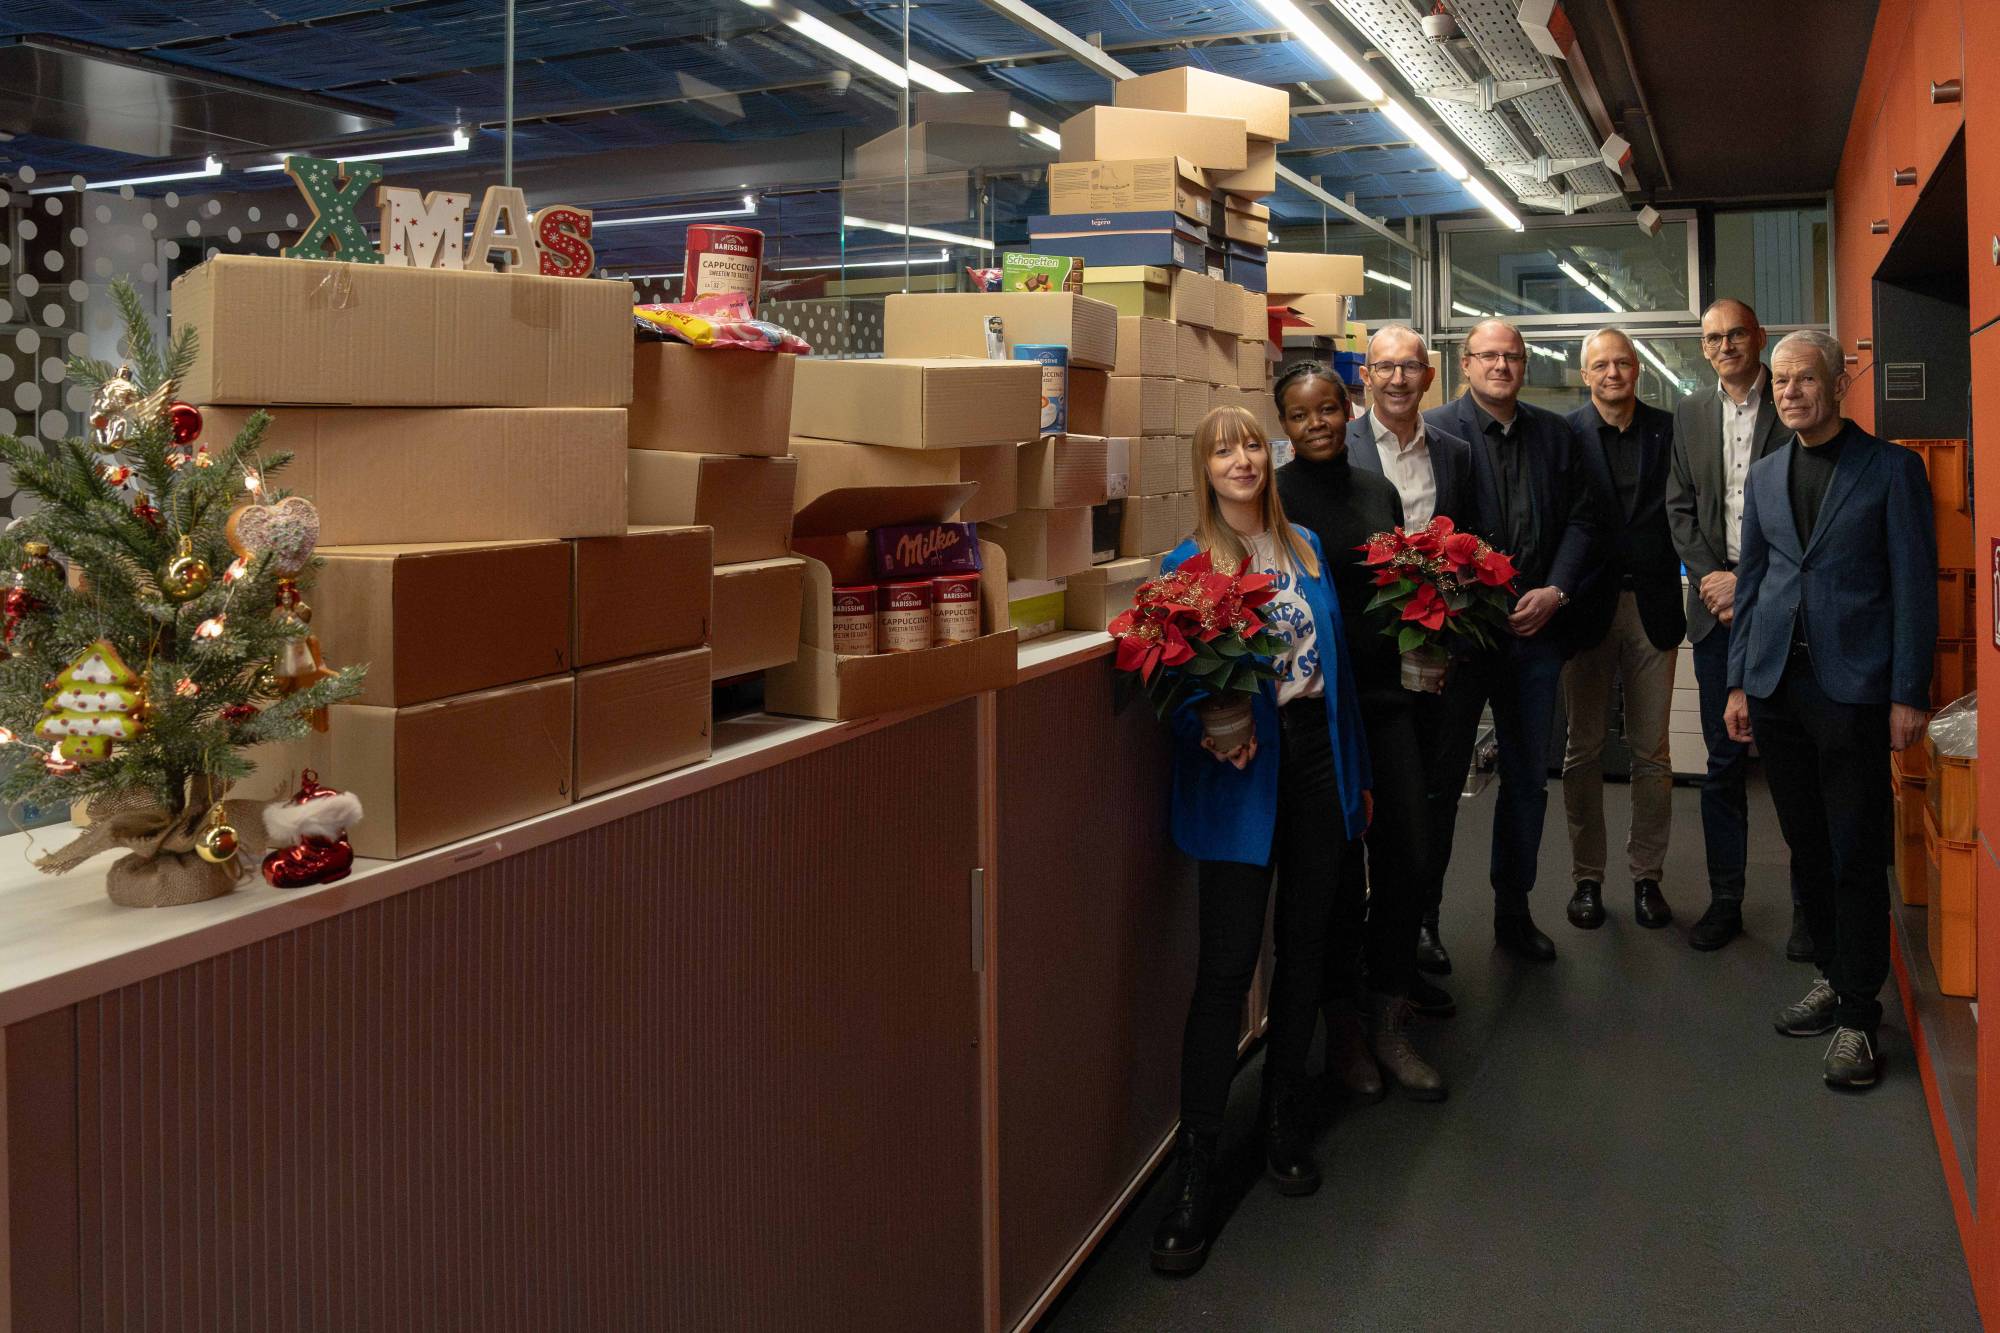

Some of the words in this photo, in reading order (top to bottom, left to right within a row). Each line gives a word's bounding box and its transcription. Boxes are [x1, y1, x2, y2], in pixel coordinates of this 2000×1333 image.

[281, 156, 594, 278] XMAS
[714, 243, 748, 252] BARISSIMO
[702, 261, 755, 273] CAPPUCCINO
[896, 526, 960, 568] Milka
[891, 600, 922, 608] BARISSIMO
[935, 608, 977, 616] CAPPUCCINO
[882, 616, 929, 625] CAPPUCCINO
[833, 623, 872, 631] PPUCCINO
